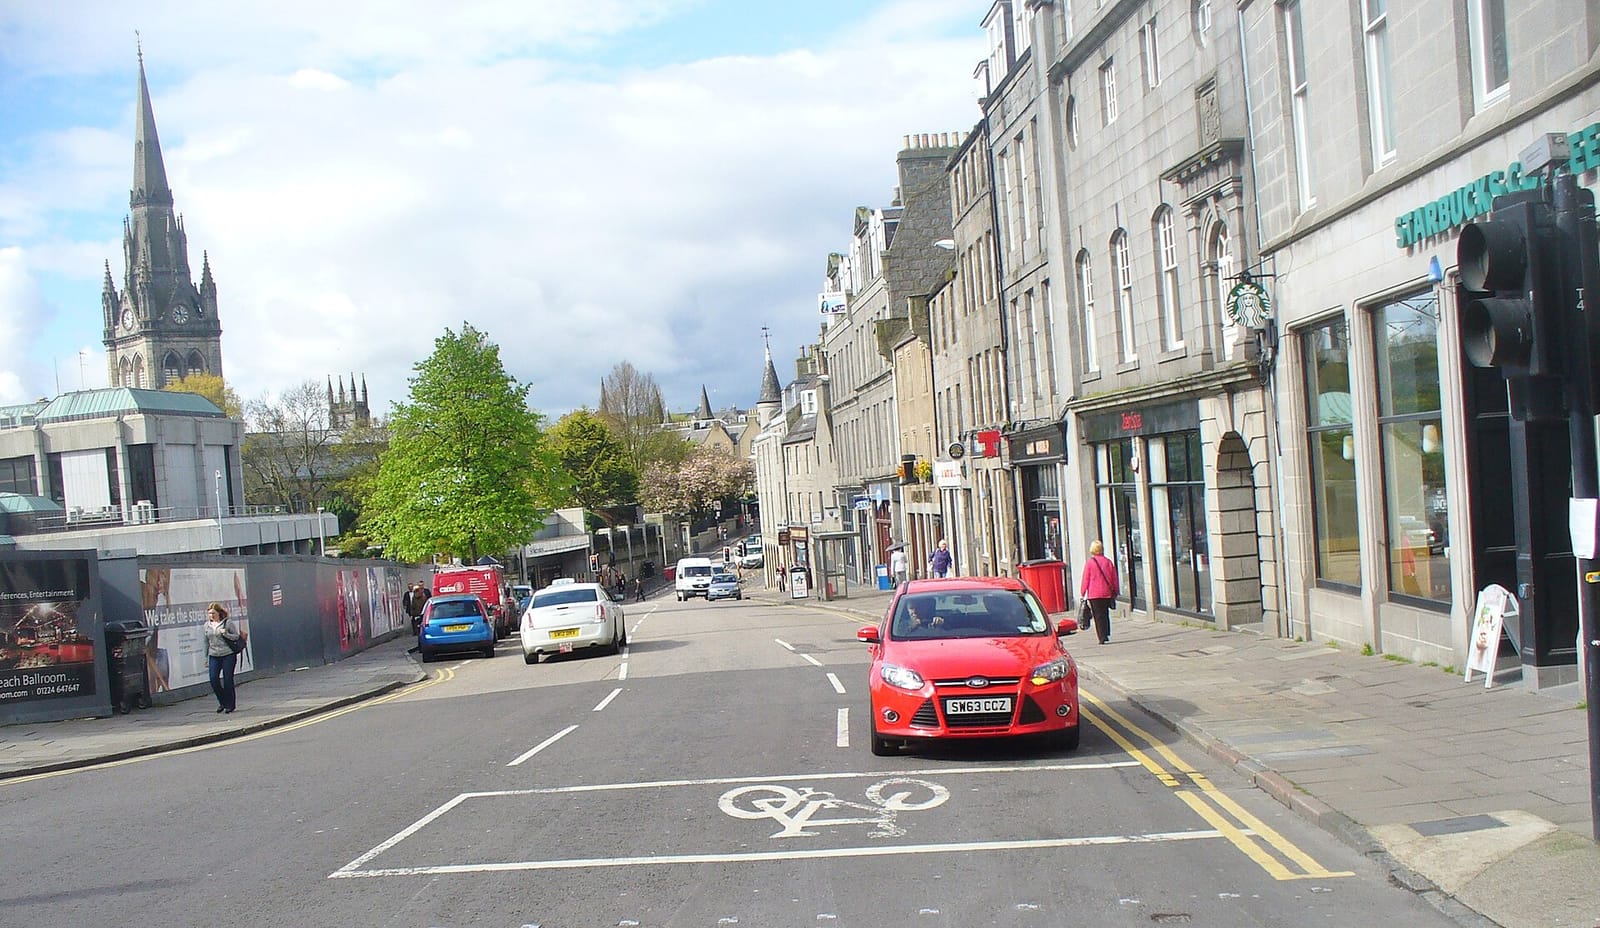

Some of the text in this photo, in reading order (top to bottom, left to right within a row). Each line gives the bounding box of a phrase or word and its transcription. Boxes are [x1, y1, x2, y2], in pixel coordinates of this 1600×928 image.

[1395, 122, 1600, 249] STARBUCKS CEE
[29, 589, 74, 599] Entertainment
[144, 609, 159, 627] We
[160, 608, 176, 625] take
[176, 607, 189, 623] the
[36, 686, 55, 695] 01224
[56, 684, 80, 693] 647647
[951, 700, 1007, 713] SW63 CCZ
